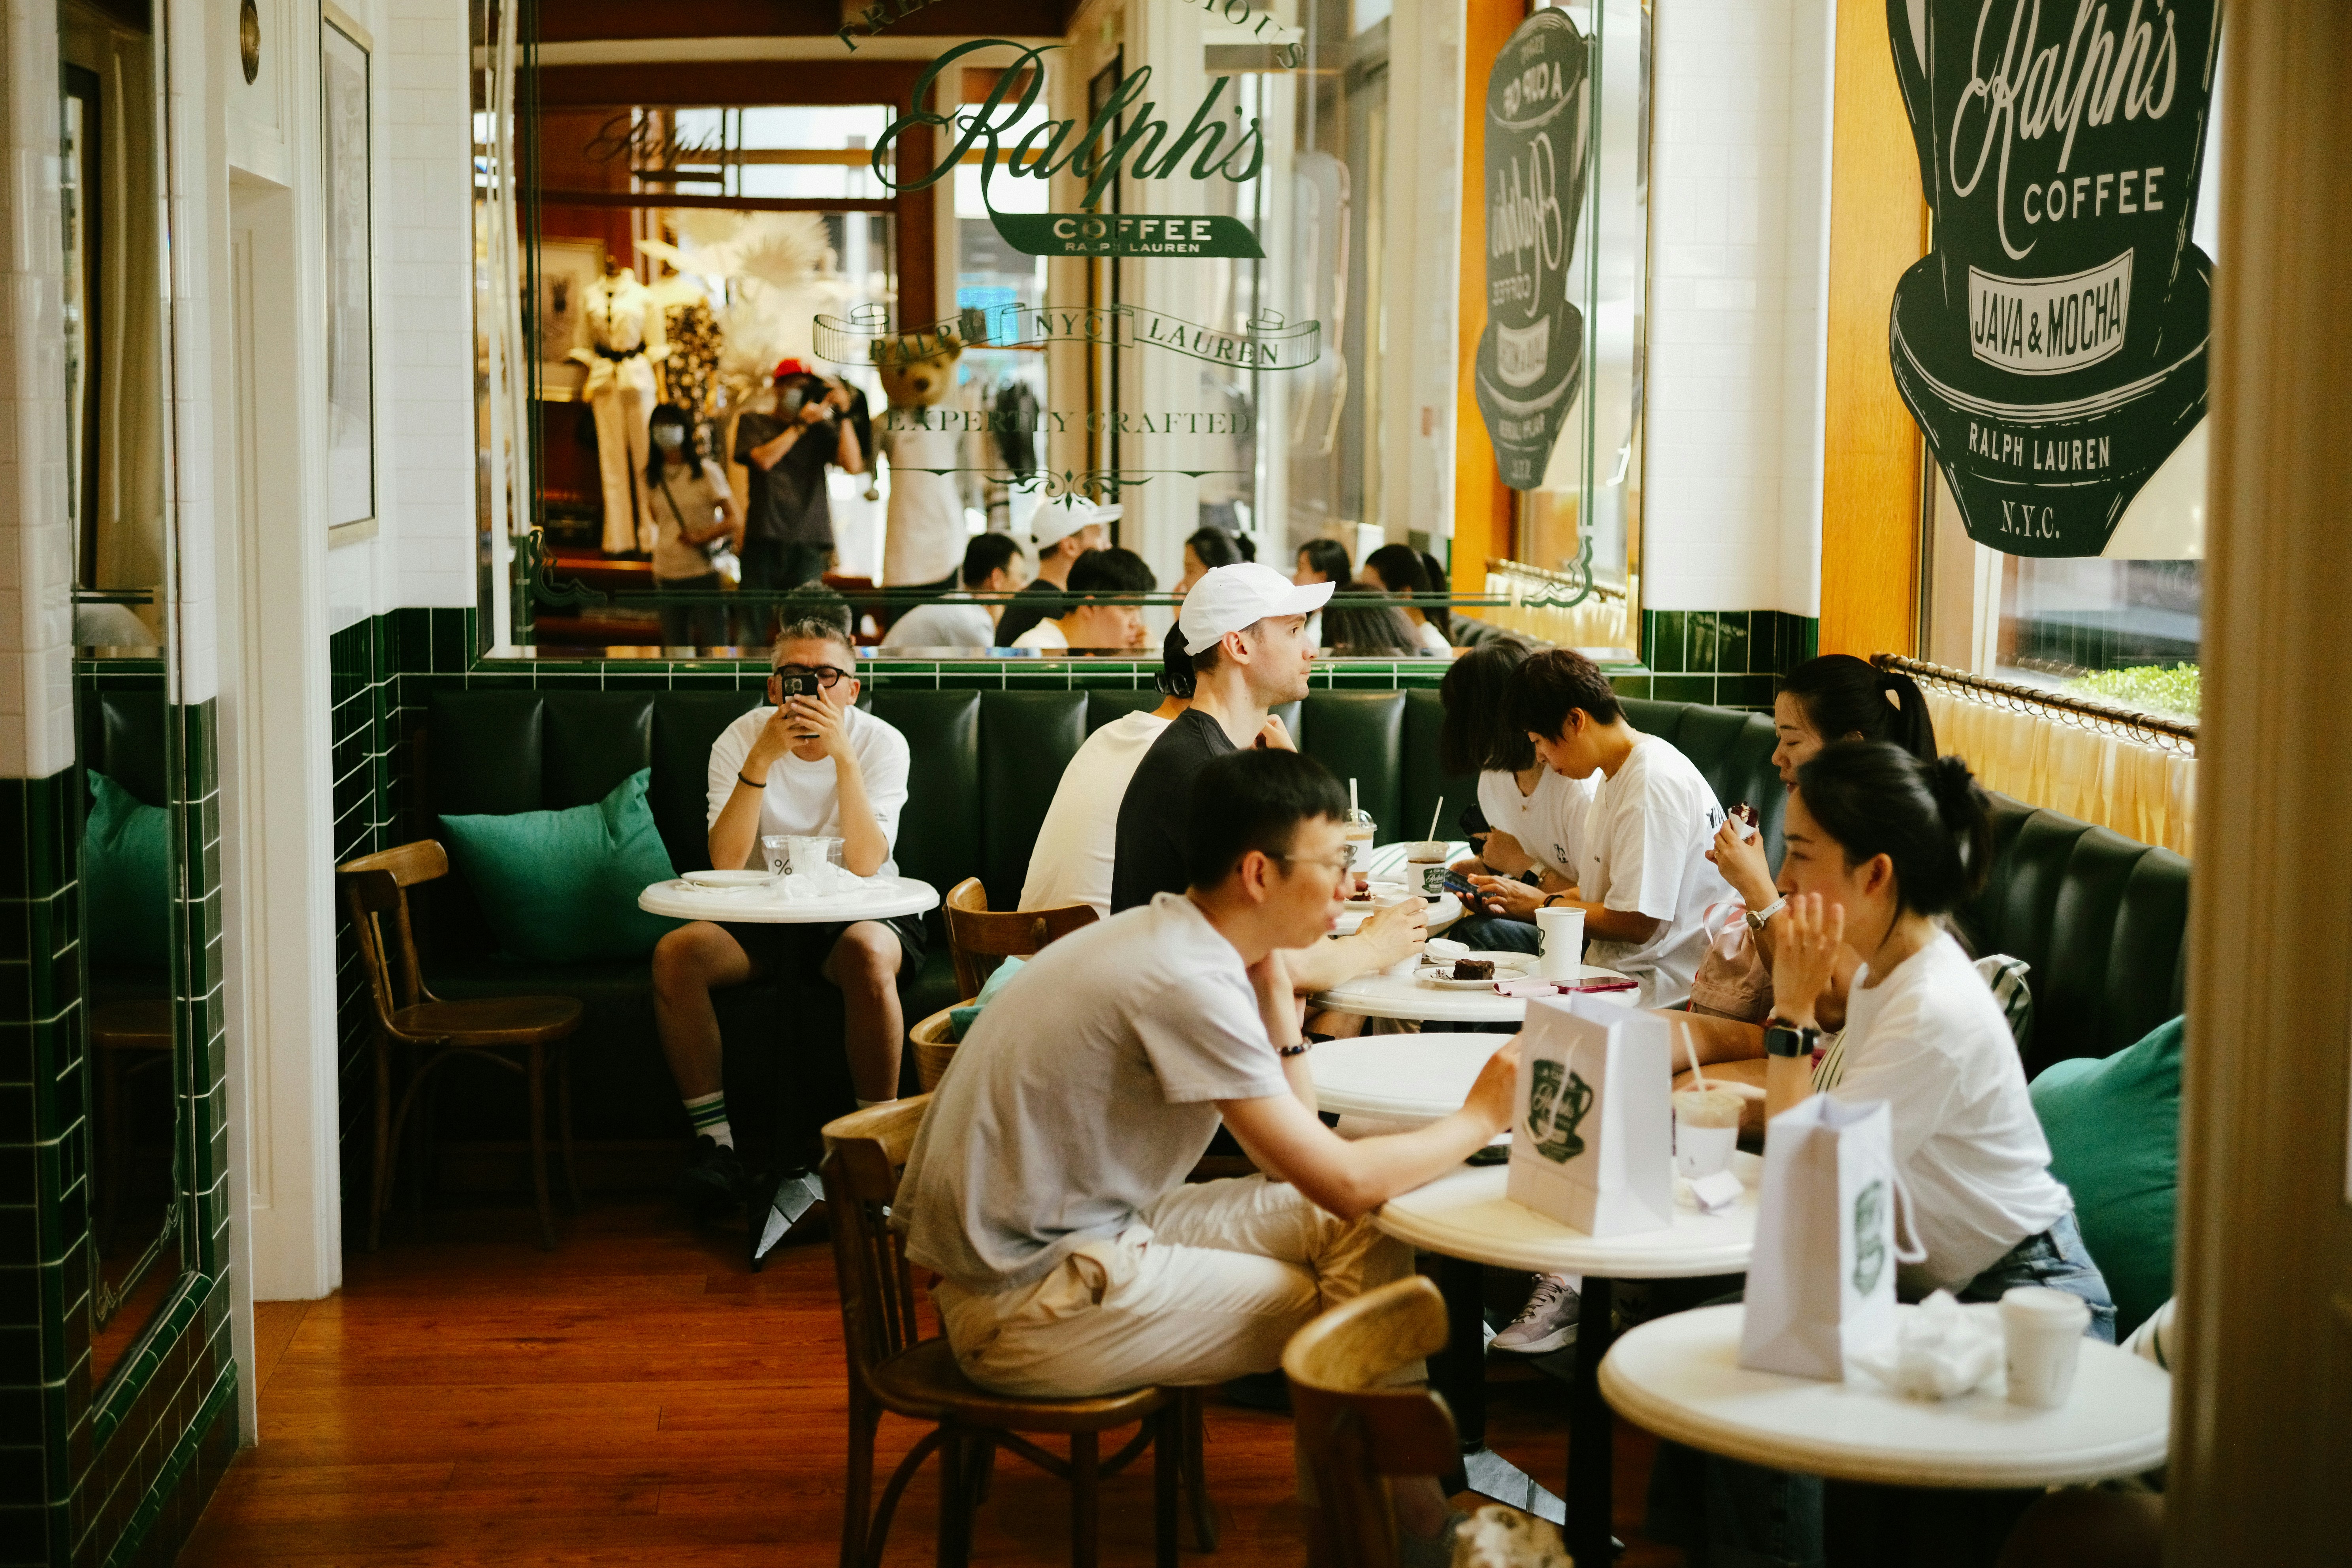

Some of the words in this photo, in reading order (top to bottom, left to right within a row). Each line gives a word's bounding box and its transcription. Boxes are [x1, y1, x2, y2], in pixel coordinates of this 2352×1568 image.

[872, 39, 1264, 215] Ralph's
[1950, 0, 2177, 260] Ralph's
[2023, 167, 2164, 224] COFFEE
[1053, 218, 1212, 241] COFFEE
[1065, 243, 1121, 252] RAP
[1129, 243, 1200, 253] LAUREN
[869, 316, 980, 364] RALPH
[1035, 313, 1104, 338] NYC
[1149, 317, 1280, 365] LAUREN
[1975, 290, 2022, 358] JAVA
[2028, 312, 2042, 355] &
[2047, 277, 2121, 358] MOCHA
[1086, 410, 1250, 434] CRAFTED
[1969, 422, 2024, 467] RALPH
[2034, 435, 2110, 471] LAUREN
[2000, 499, 2060, 539] N.Y.C.
